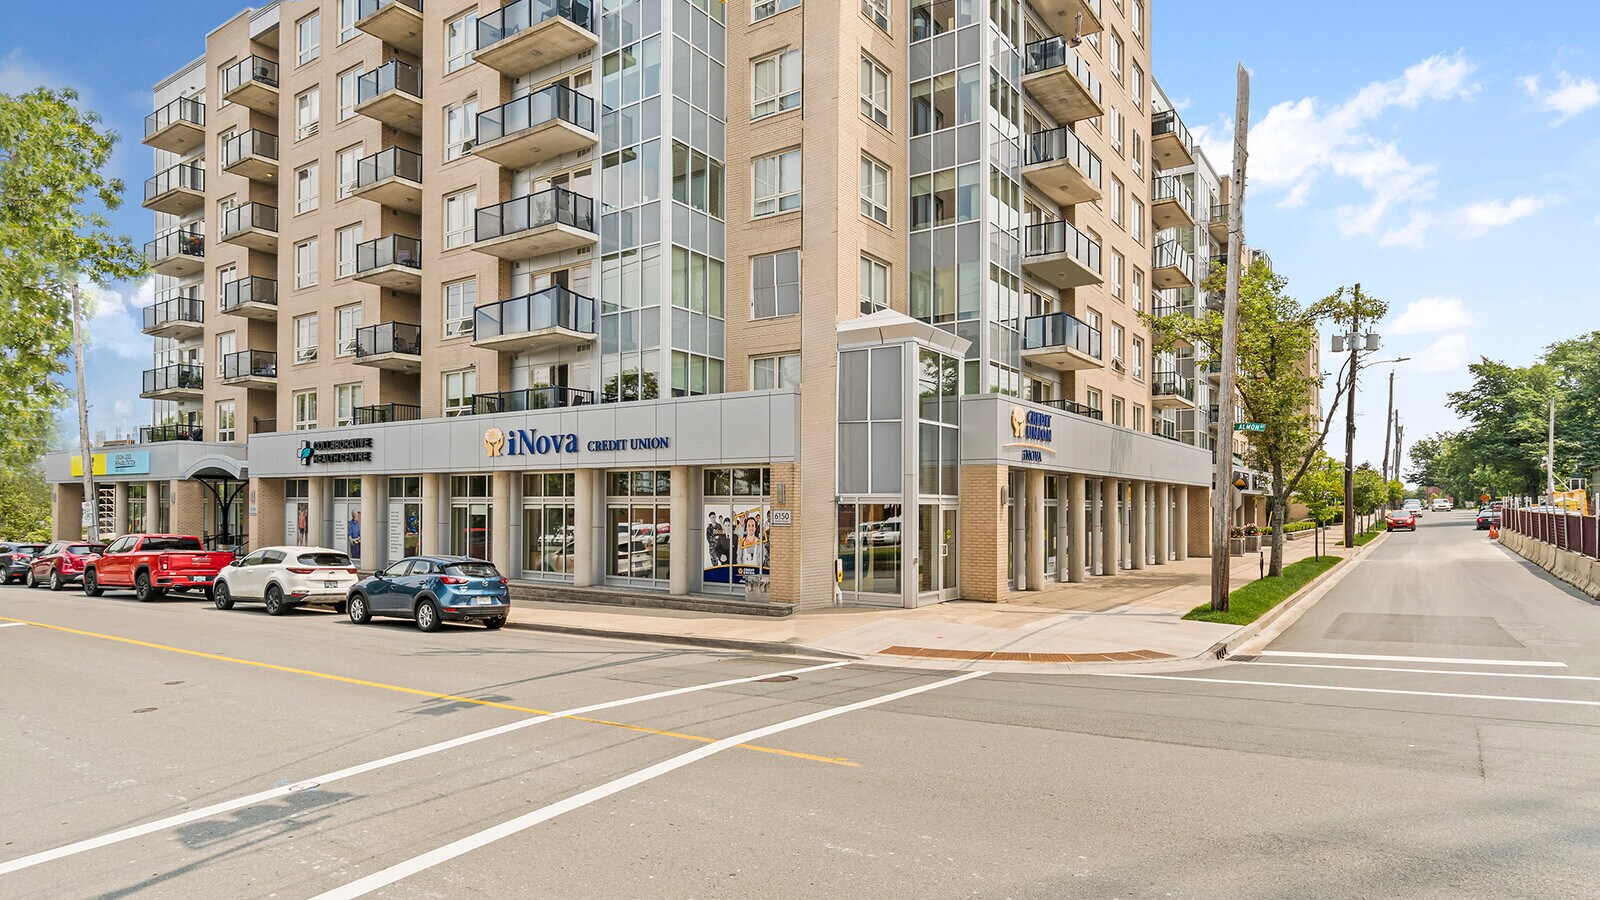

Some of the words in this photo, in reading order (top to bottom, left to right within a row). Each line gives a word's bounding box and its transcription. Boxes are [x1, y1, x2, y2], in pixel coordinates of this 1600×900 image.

[1026, 410, 1052, 427] CREDIT
[1025, 425, 1052, 442] UNION
[313, 438, 373, 450] COLLABORATIVE
[507, 429, 579, 456] iNova
[587, 439, 627, 452] CREDIT
[630, 437, 669, 450] UNION
[313, 453, 340, 463] HEALTH
[340, 452, 372, 462] CENTRE
[774, 512, 790, 520] 6150
